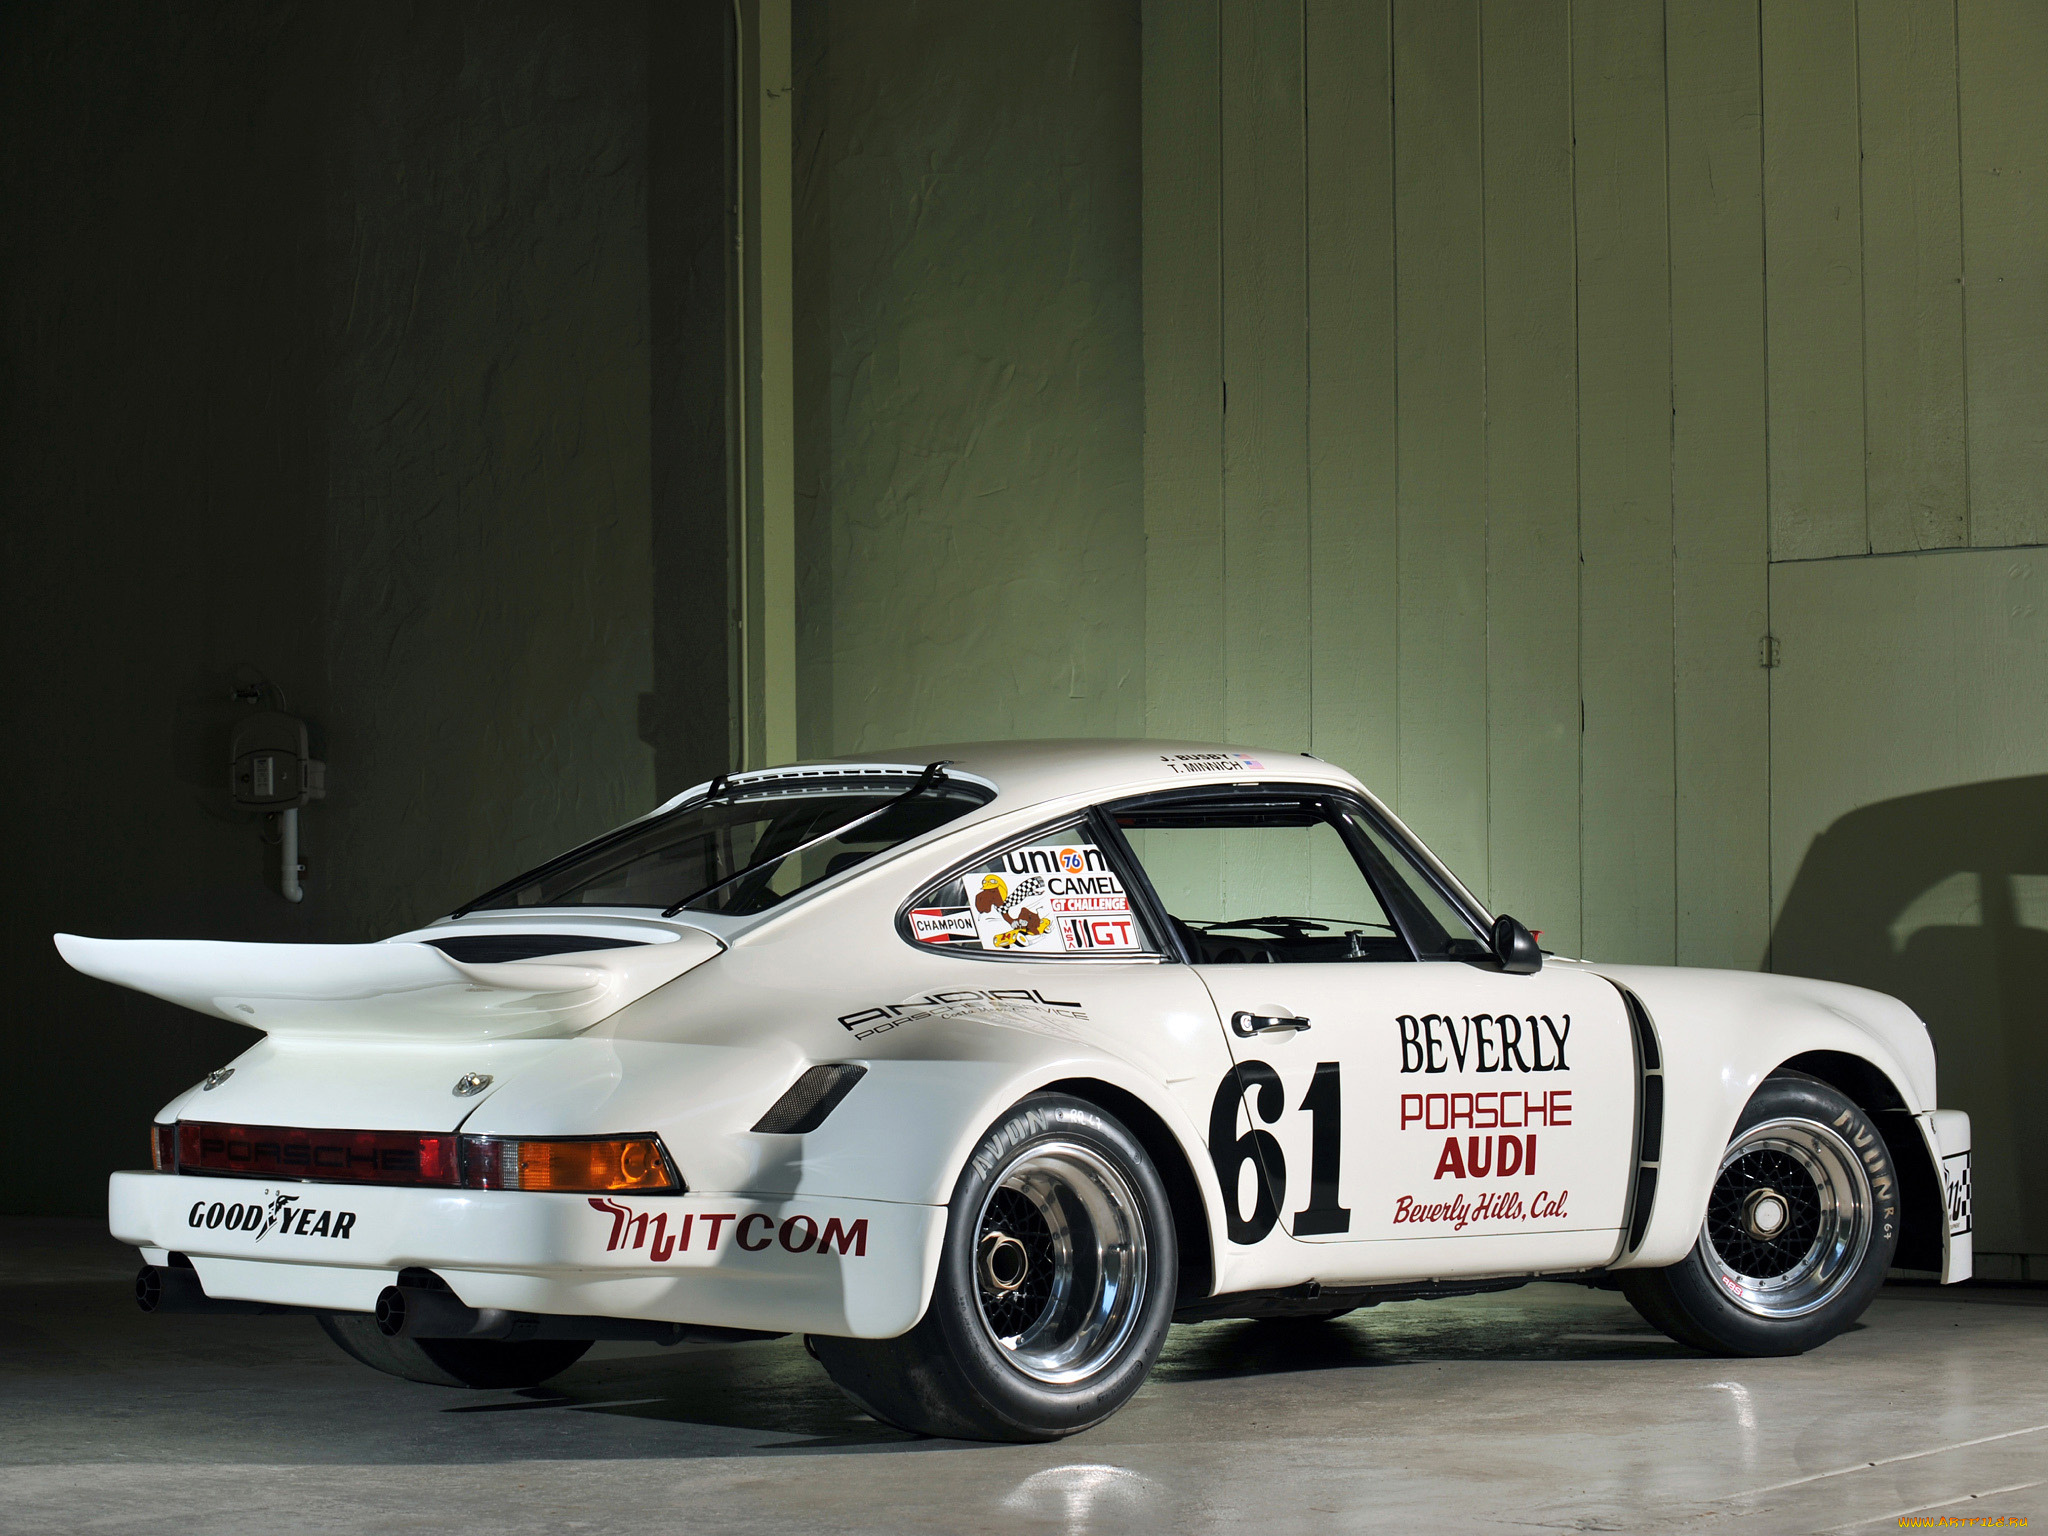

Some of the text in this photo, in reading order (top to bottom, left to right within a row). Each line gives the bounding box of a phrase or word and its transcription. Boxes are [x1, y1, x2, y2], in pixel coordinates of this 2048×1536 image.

[1167, 761, 1244, 773] T. MINNICH
[1048, 877, 1124, 896] CAMEL
[1052, 899, 1127, 912] GT CHALLENGE
[917, 918, 973, 932] CHAMPION
[1091, 921, 1132, 945] GT
[837, 989, 1082, 1032] ANDIAL
[1396, 1013, 1571, 1074] BEVERLY
[1400, 1090, 1572, 1131] PORSCHE
[202, 1138, 416, 1170] PORSCHE
[971, 1107, 1050, 1182] AVON
[1208, 1060, 1351, 1245] 61
[1433, 1134, 1537, 1180] AUDI
[588, 1198, 868, 1262] MITCOM
[1393, 1190, 1568, 1231] Beverly Hills, Cal.
